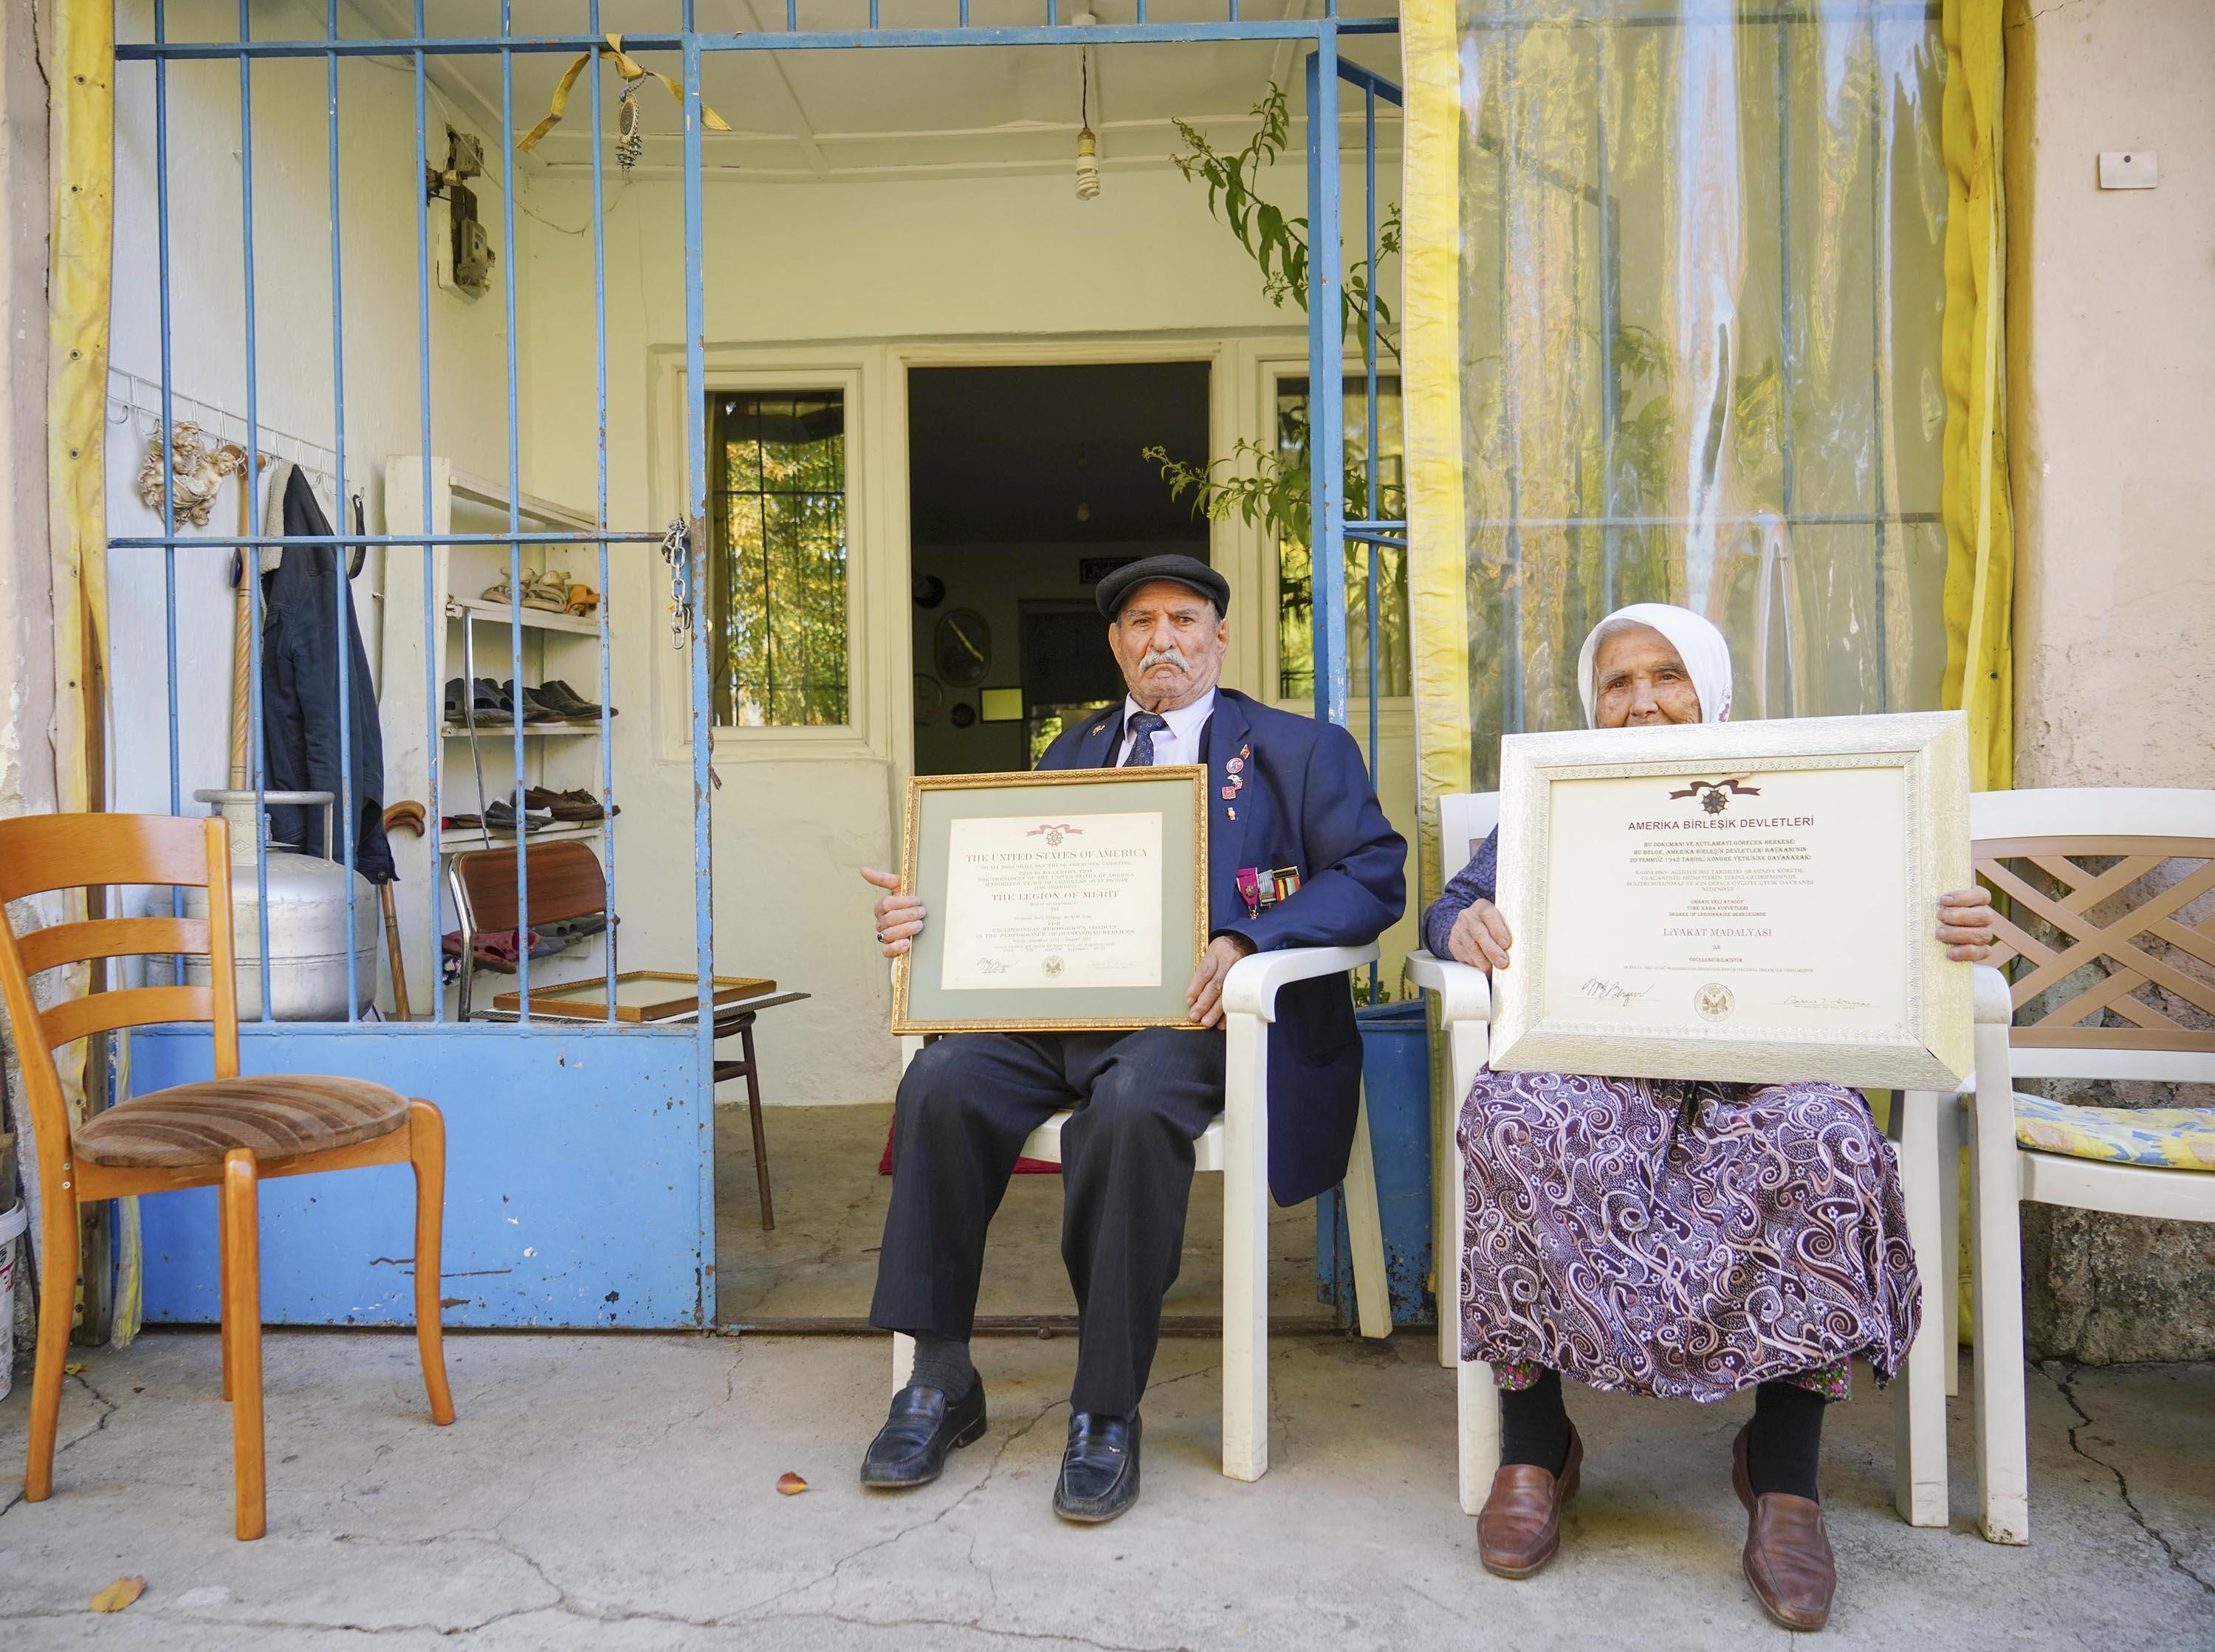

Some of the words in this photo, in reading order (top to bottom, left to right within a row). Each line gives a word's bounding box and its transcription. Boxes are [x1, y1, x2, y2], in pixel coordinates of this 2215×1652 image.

[1628, 819, 1680, 830] AMERİKA
[1683, 818, 1737, 830] BİRLEŞİK
[1740, 815, 1813, 827] DEVLETLERİ
[966, 854, 988, 862] THE
[992, 853, 1033, 861] UNITED
[1036, 851, 1076, 859] STATES
[1097, 849, 1147, 857] AMERICA
[1082, 890, 1120, 898] MERIT
[1710, 929, 1772, 937] MADALYASI
